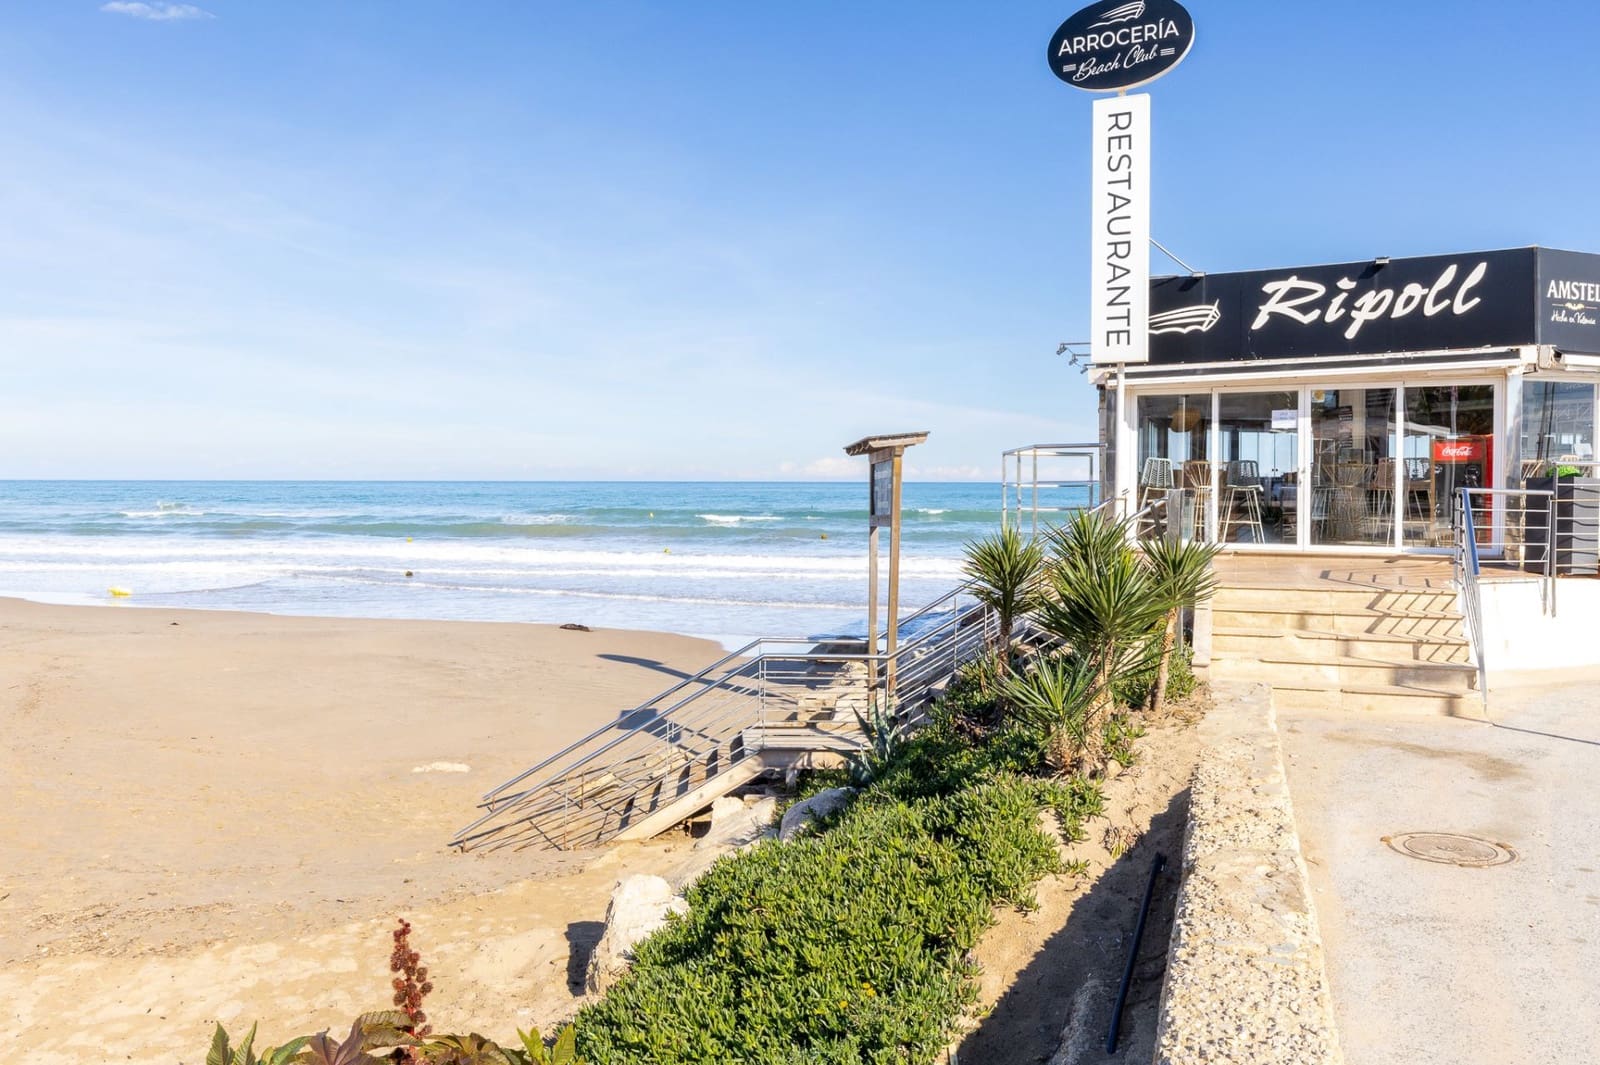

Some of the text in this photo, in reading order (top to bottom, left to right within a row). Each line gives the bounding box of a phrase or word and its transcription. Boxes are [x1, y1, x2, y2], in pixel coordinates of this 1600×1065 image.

[1058, 18, 1180, 57] ARROCERÍA
[1072, 44, 1158, 82] Beach Club
[1106, 111, 1132, 347] RESTAURANTE
[1251, 262, 1487, 340] Ripoll
[1546, 279, 1600, 302] AMSTEL
